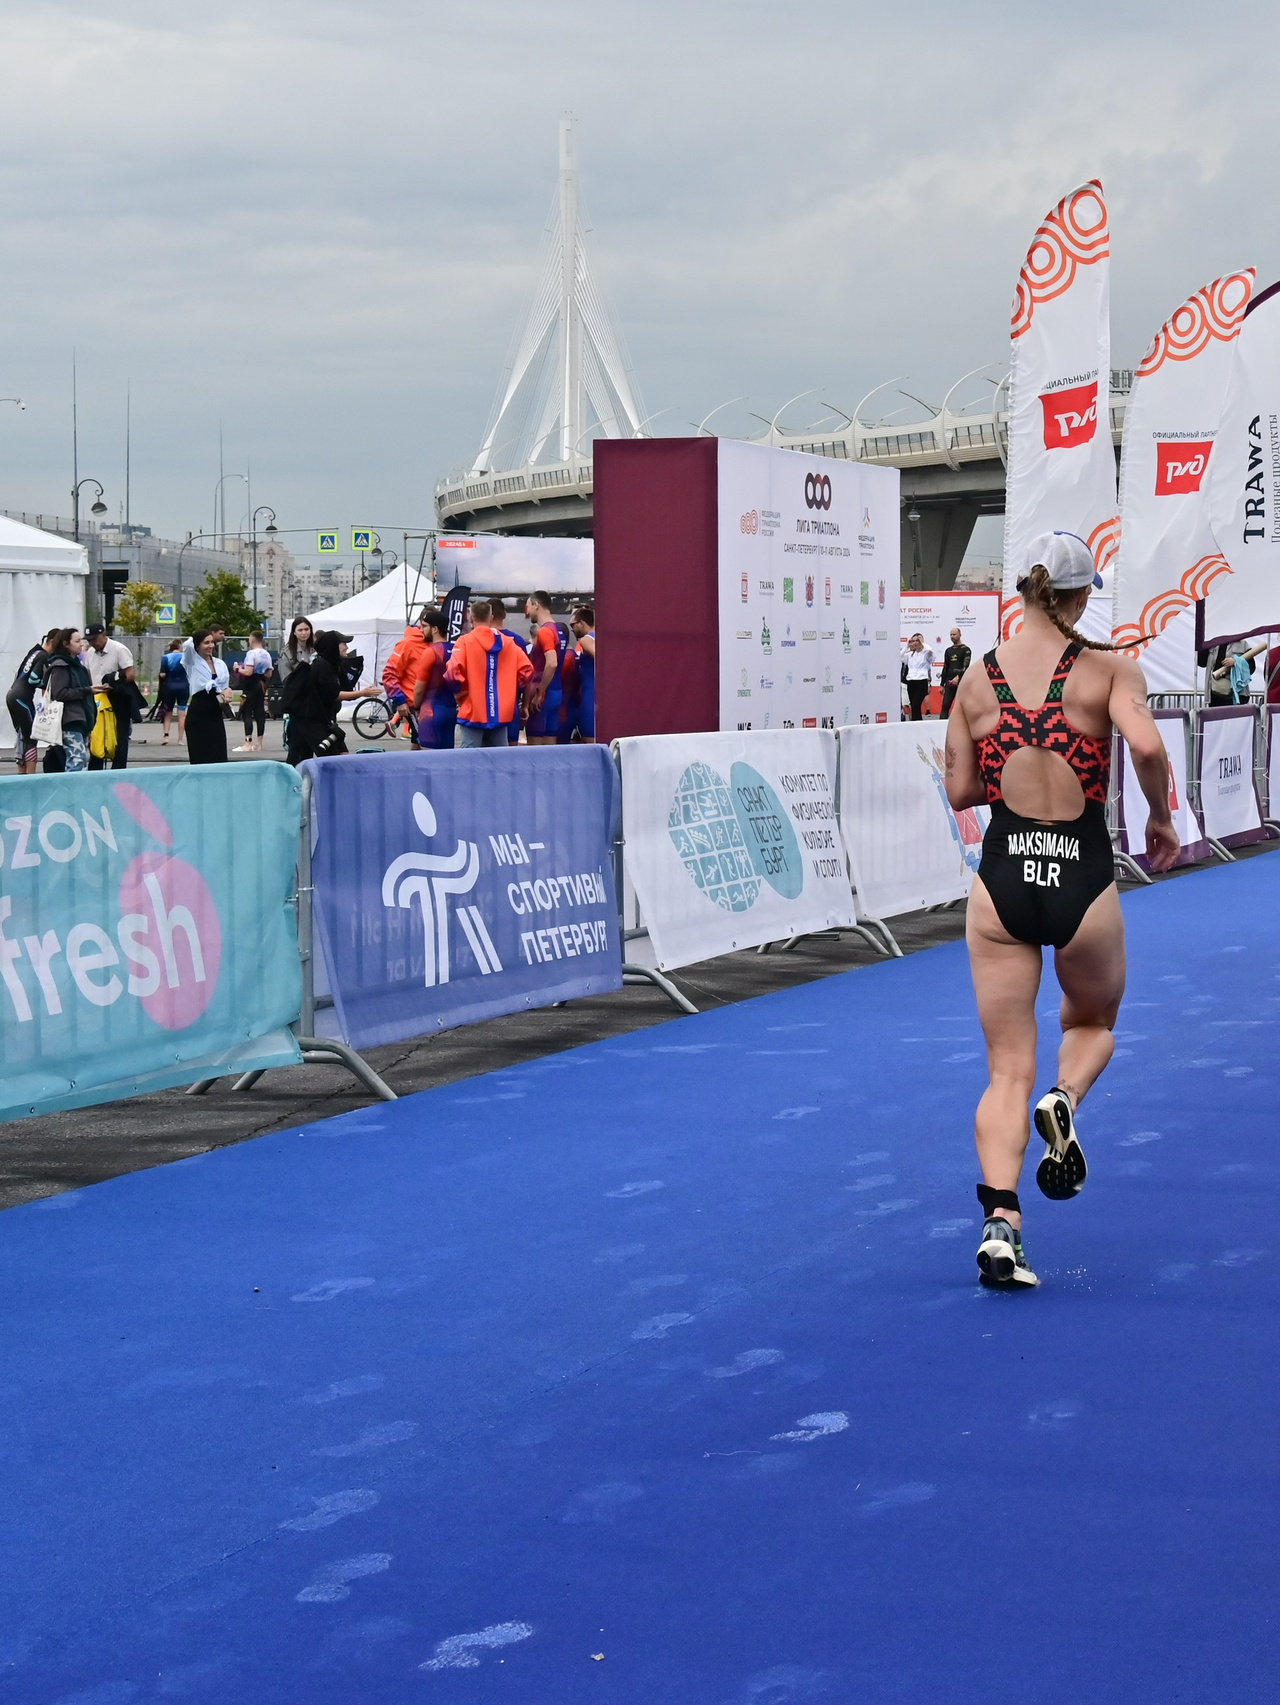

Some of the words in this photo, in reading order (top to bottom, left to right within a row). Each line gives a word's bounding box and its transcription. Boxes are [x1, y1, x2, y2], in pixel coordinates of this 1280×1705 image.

[1042, 371, 1092, 391] ЦИАЛЬНЫЙ
[1152, 430, 1200, 439] ОФИЦИАЛЬНЫЙ
[1200, 430, 1218, 439] ПАРТНЕ
[1243, 415, 1265, 544] TRAWA
[796, 519, 811, 534] ЛИГА
[811, 521, 840, 536] ТРИАТЛОНА
[1219, 755, 1242, 779] TRAWA
[778, 774, 817, 793] КОМИТЕТ
[816, 773, 829, 792] ПО
[736, 785, 773, 813] САНКТ
[0, 805, 118, 870] ZON
[749, 815, 782, 844] ПЕТЕР
[489, 833, 530, 866] МЫ
[760, 846, 789, 875] БУРГ
[1007, 831, 1080, 861] MAKSIMAVA
[1024, 860, 1060, 888] BLR
[507, 866, 608, 915] СПОРТИВ
[0, 872, 206, 1023] fresh
